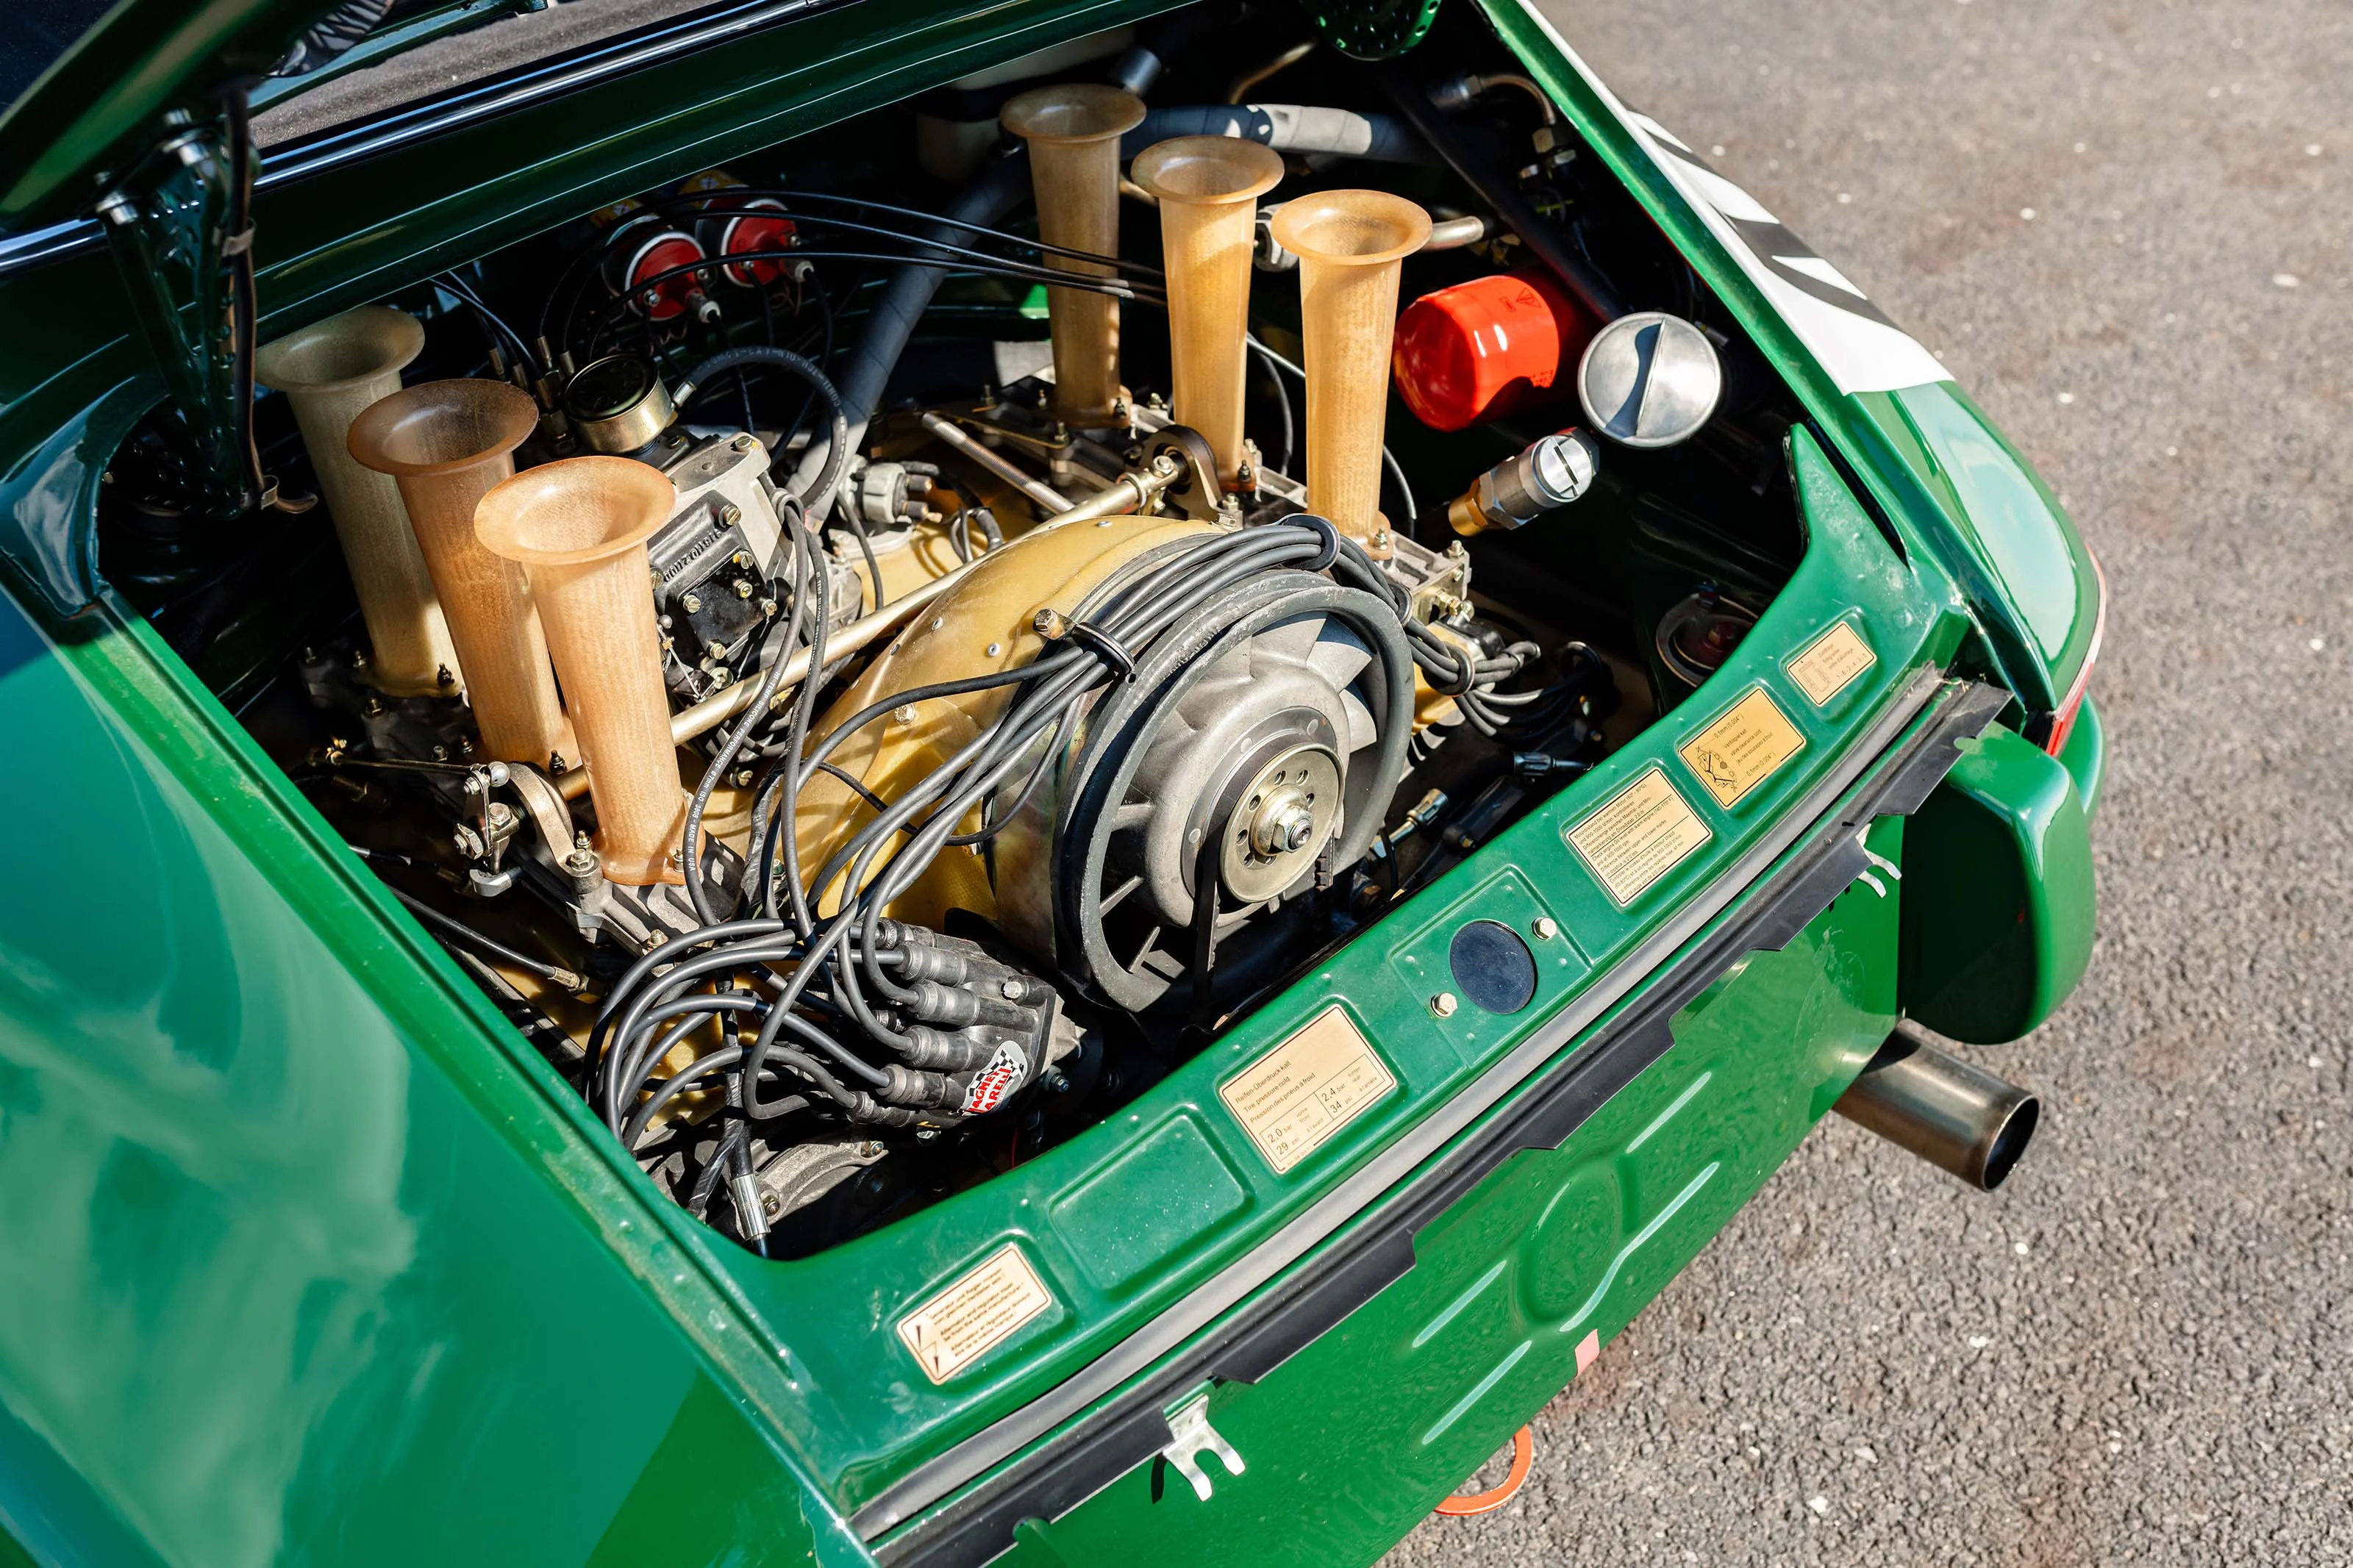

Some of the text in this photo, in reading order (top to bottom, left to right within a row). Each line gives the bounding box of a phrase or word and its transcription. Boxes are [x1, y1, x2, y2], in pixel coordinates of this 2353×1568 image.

[774, 671, 781, 680] HI
[764, 680, 776, 699] TEMP
[744, 701, 765, 728] SILICONE
[715, 728, 746, 769] PERFORMANCE
[697, 791, 707, 803] ISO
[688, 823, 697, 843] MADE
[688, 845, 696, 856] IN
[688, 858, 696, 872] USA
[1235, 1059, 1290, 1103] Reifen-Überdruck kalt
[1337, 1083, 1345, 1091] bar
[1244, 1076, 1290, 1111] Tire pressure cold
[1250, 1103, 1274, 1123] Pression
[1273, 1096, 1284, 1106] des
[1283, 1085, 1299, 1099] pneus
[1302, 1072, 1315, 1084] froid
[1329, 1100, 1342, 1113] 34
[1267, 1128, 1283, 1144] 2,0
[1276, 1141, 1289, 1154] 29
